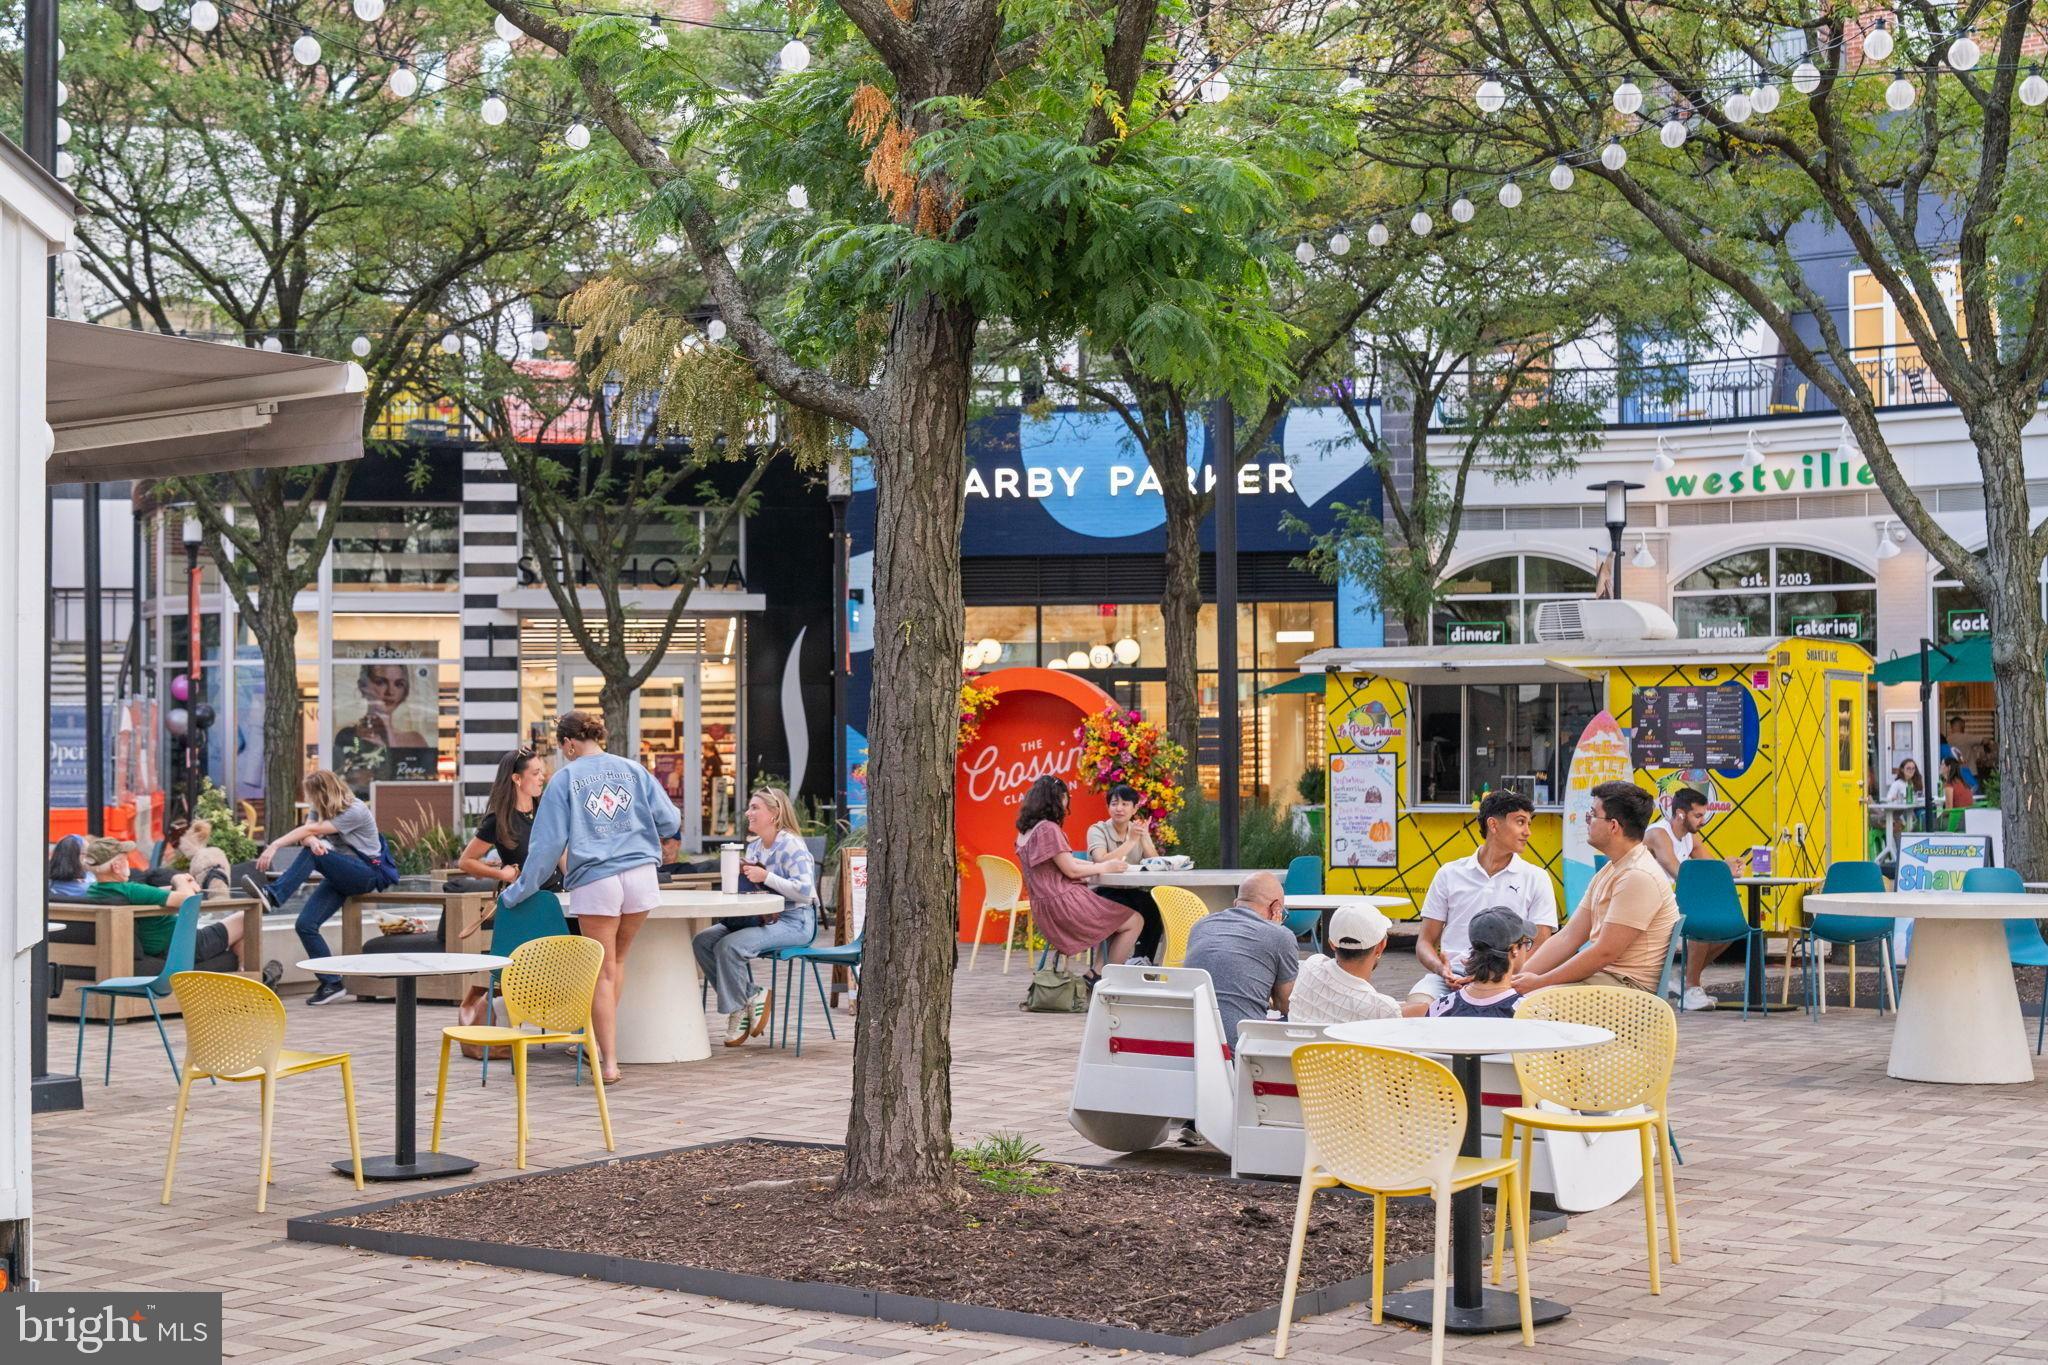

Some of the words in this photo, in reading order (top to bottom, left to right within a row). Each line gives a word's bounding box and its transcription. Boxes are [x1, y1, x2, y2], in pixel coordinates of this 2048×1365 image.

[1665, 452, 1875, 497] westville
[1740, 573, 1768, 587] est.
[1779, 573, 1812, 586] 2003
[1698, 621, 1746, 638] brunch
[1795, 618, 1858, 639] catering
[1952, 613, 1990, 632] cock
[1450, 626, 1501, 642] dinner
[346, 647, 375, 659] Rare
[378, 647, 422, 659] Beauty
[1806, 648, 1829, 662] SHAVED
[1829, 650, 1839, 663] ICE
[1020, 739, 1044, 753] THE
[1913, 844, 1966, 856] Hawaiian
[1898, 864, 1967, 891] Shav
